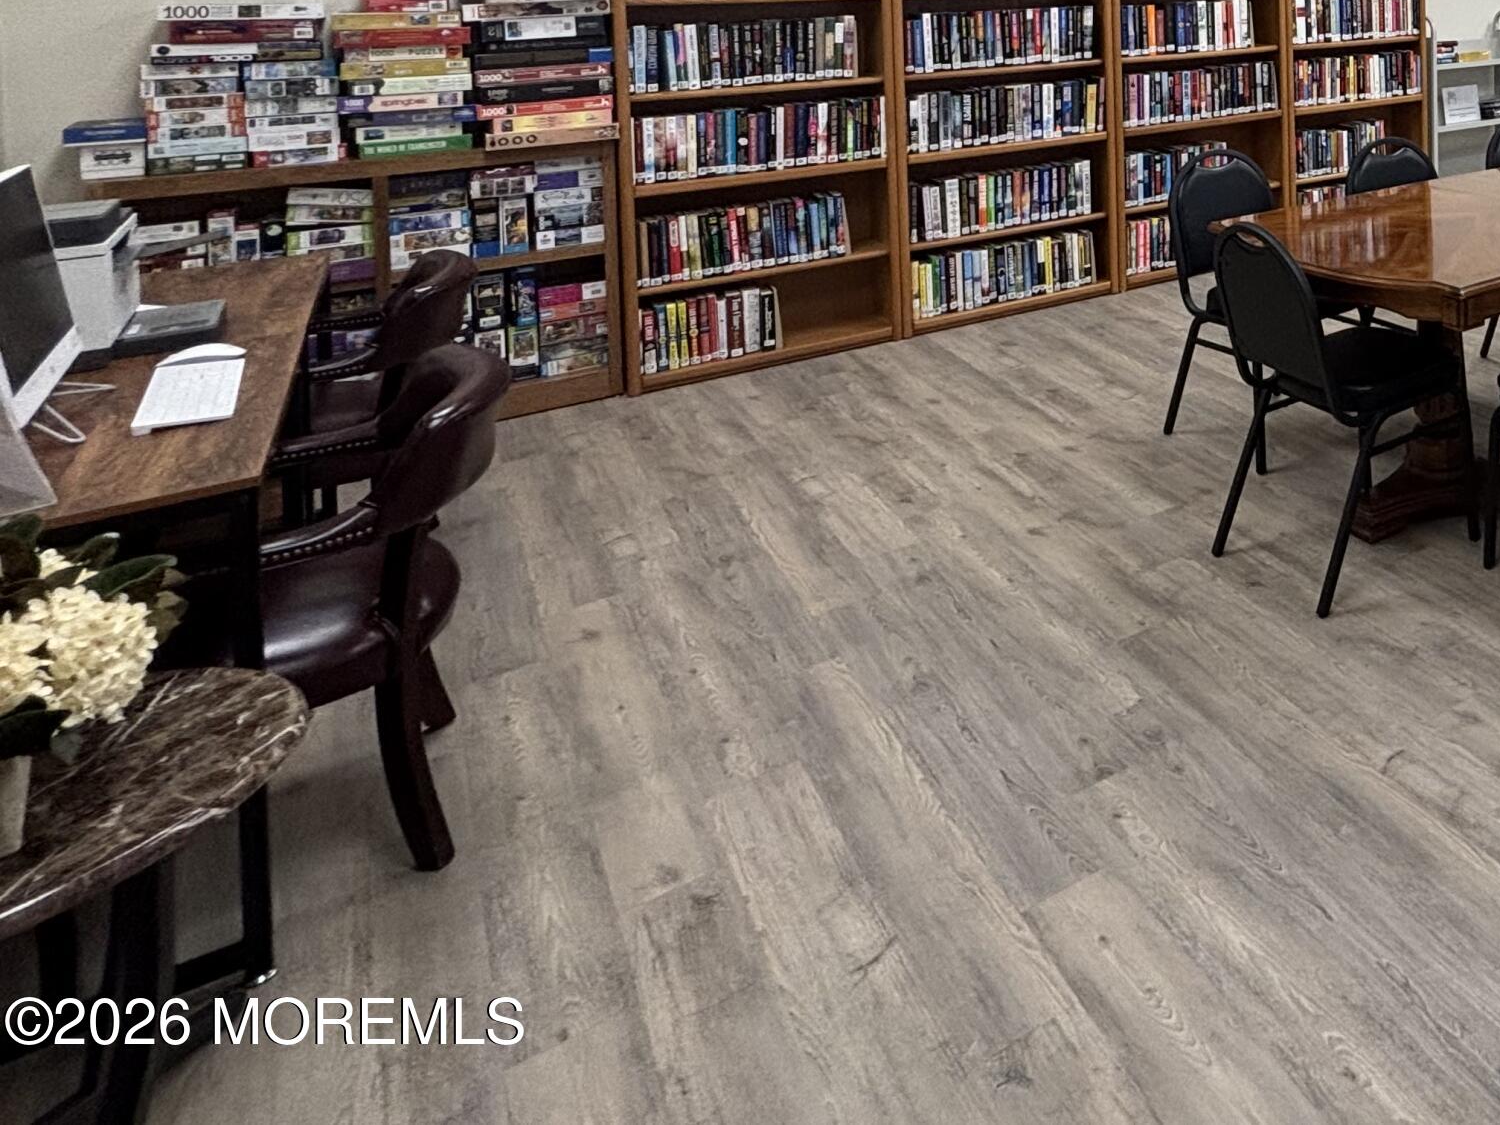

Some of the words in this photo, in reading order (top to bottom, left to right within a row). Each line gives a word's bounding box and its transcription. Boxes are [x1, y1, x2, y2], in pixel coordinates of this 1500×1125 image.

[163, 5, 210, 19] 1000
[211, 53, 253, 63] 1000
[479, 72, 503, 83] 1000
[963, 94, 971, 121] AUTOPSY
[481, 109, 506, 118] 1000
